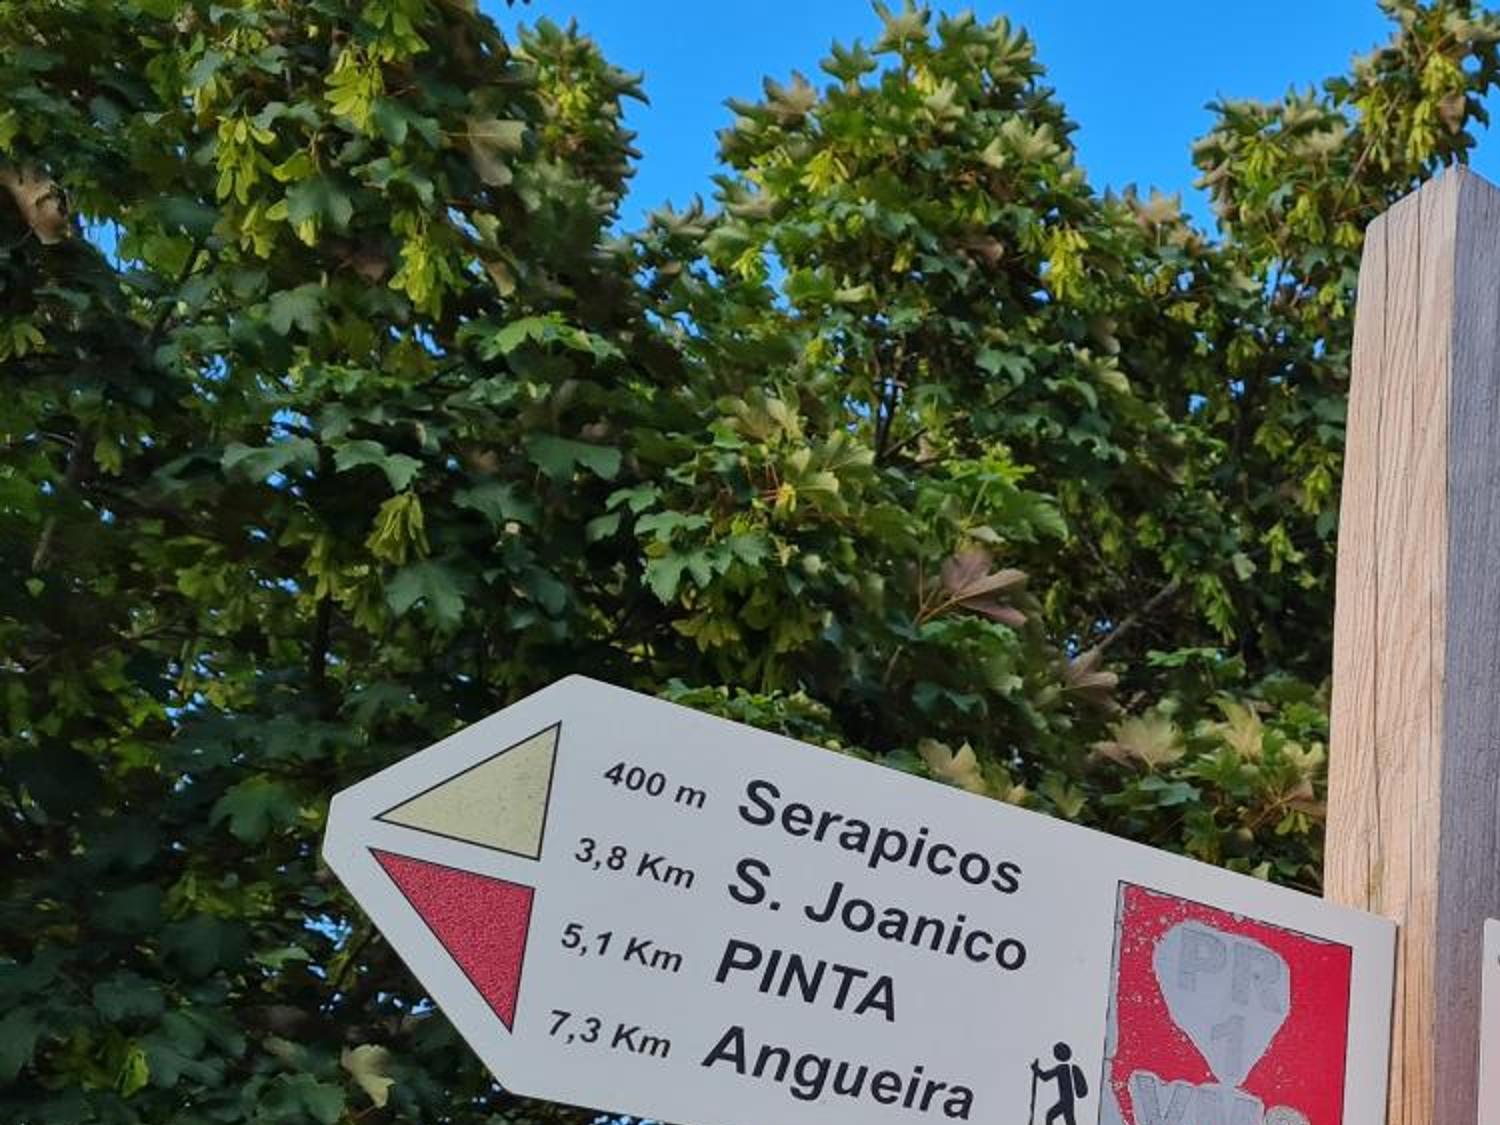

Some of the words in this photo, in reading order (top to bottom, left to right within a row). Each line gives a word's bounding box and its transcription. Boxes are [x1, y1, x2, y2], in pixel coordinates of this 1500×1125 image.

[604, 762, 666, 797] 400
[674, 785, 707, 809] m
[738, 779, 1022, 895] Serapicos
[575, 837, 627, 871] 3,8
[636, 853, 695, 889] Km
[727, 858, 781, 911] S.
[804, 881, 1027, 971] Joanico
[561, 923, 613, 957] 5,1
[623, 937, 683, 973] Km
[715, 939, 896, 1023] PINTA
[549, 1009, 602, 1044] 7,3
[611, 1023, 671, 1059] Km
[701, 1025, 974, 1121] Angueira
